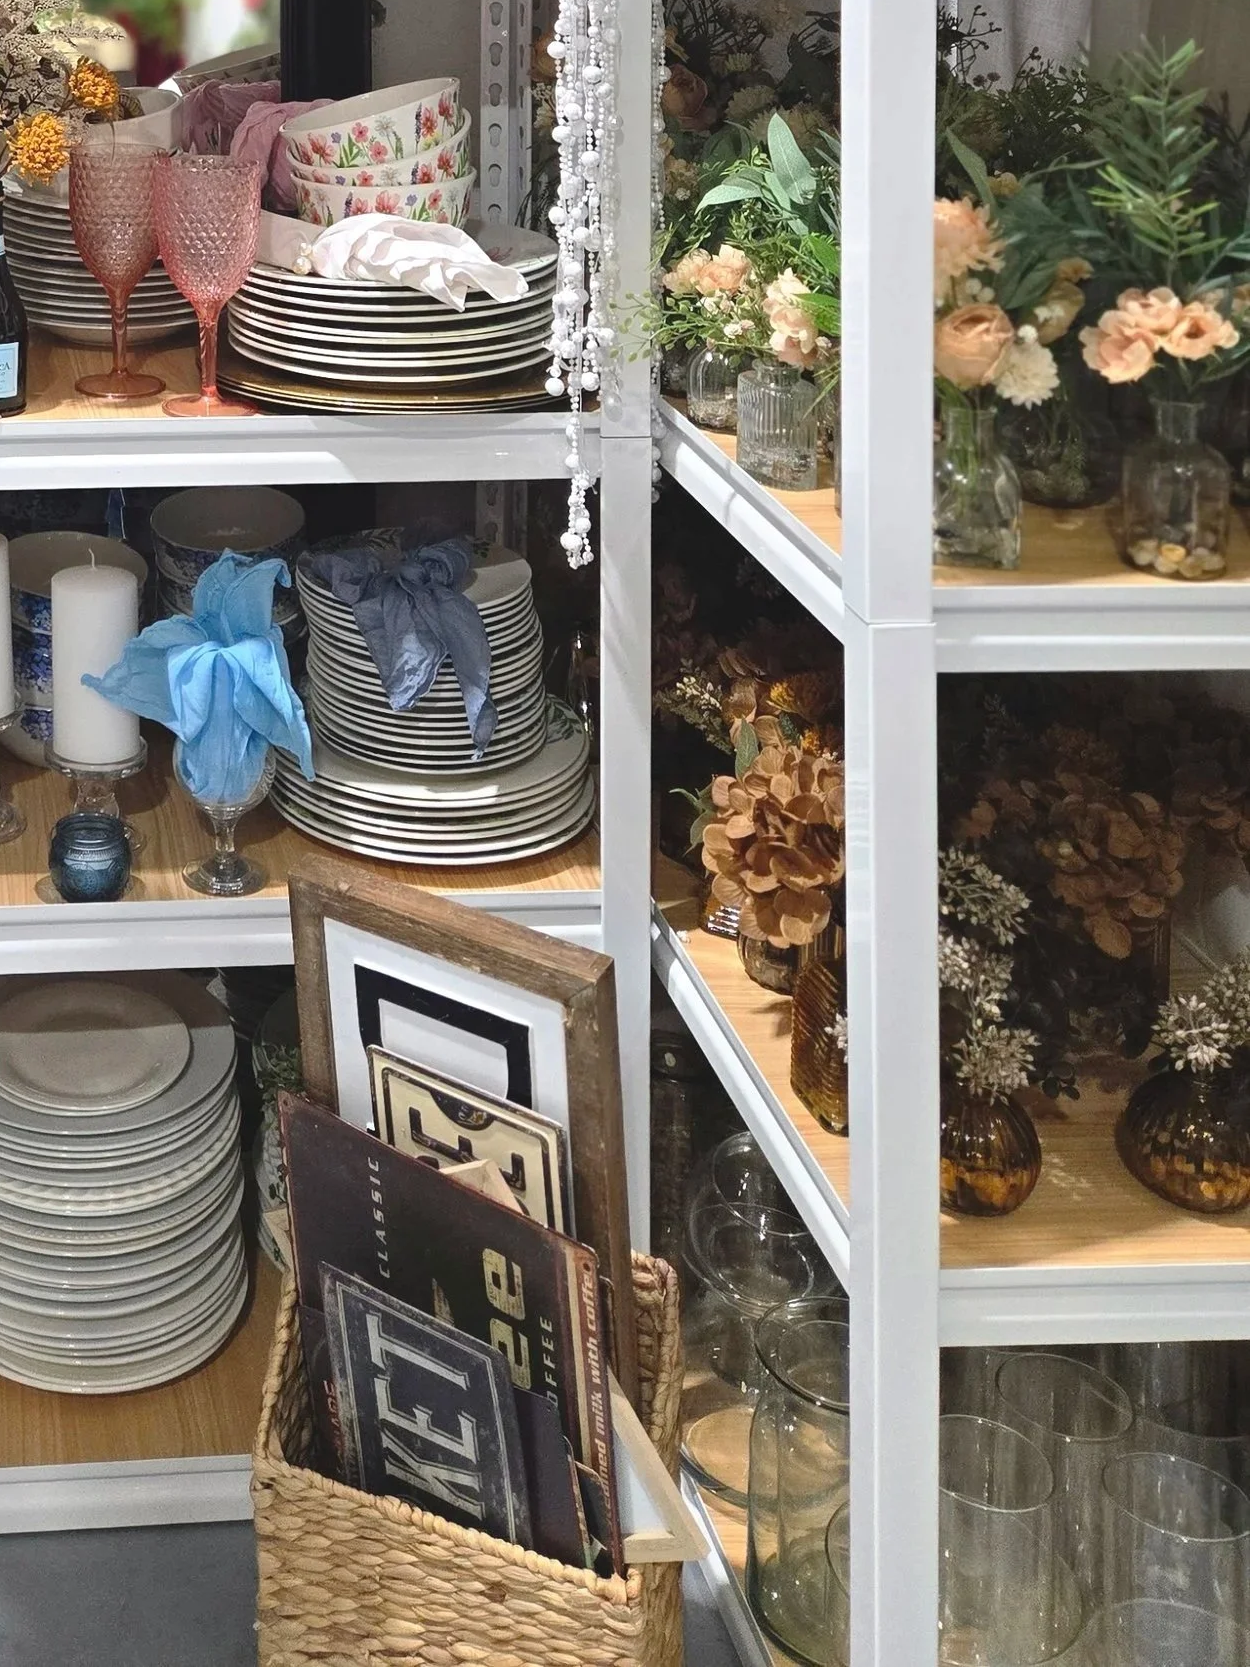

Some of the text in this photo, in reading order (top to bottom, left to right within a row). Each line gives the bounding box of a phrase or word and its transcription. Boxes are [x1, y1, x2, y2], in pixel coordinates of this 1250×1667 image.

[366, 1156, 391, 1279] CLASSIC
[539, 1315, 559, 1414] OFFEE
[587, 1336, 602, 1385] with
[591, 1390, 606, 1436] milk
